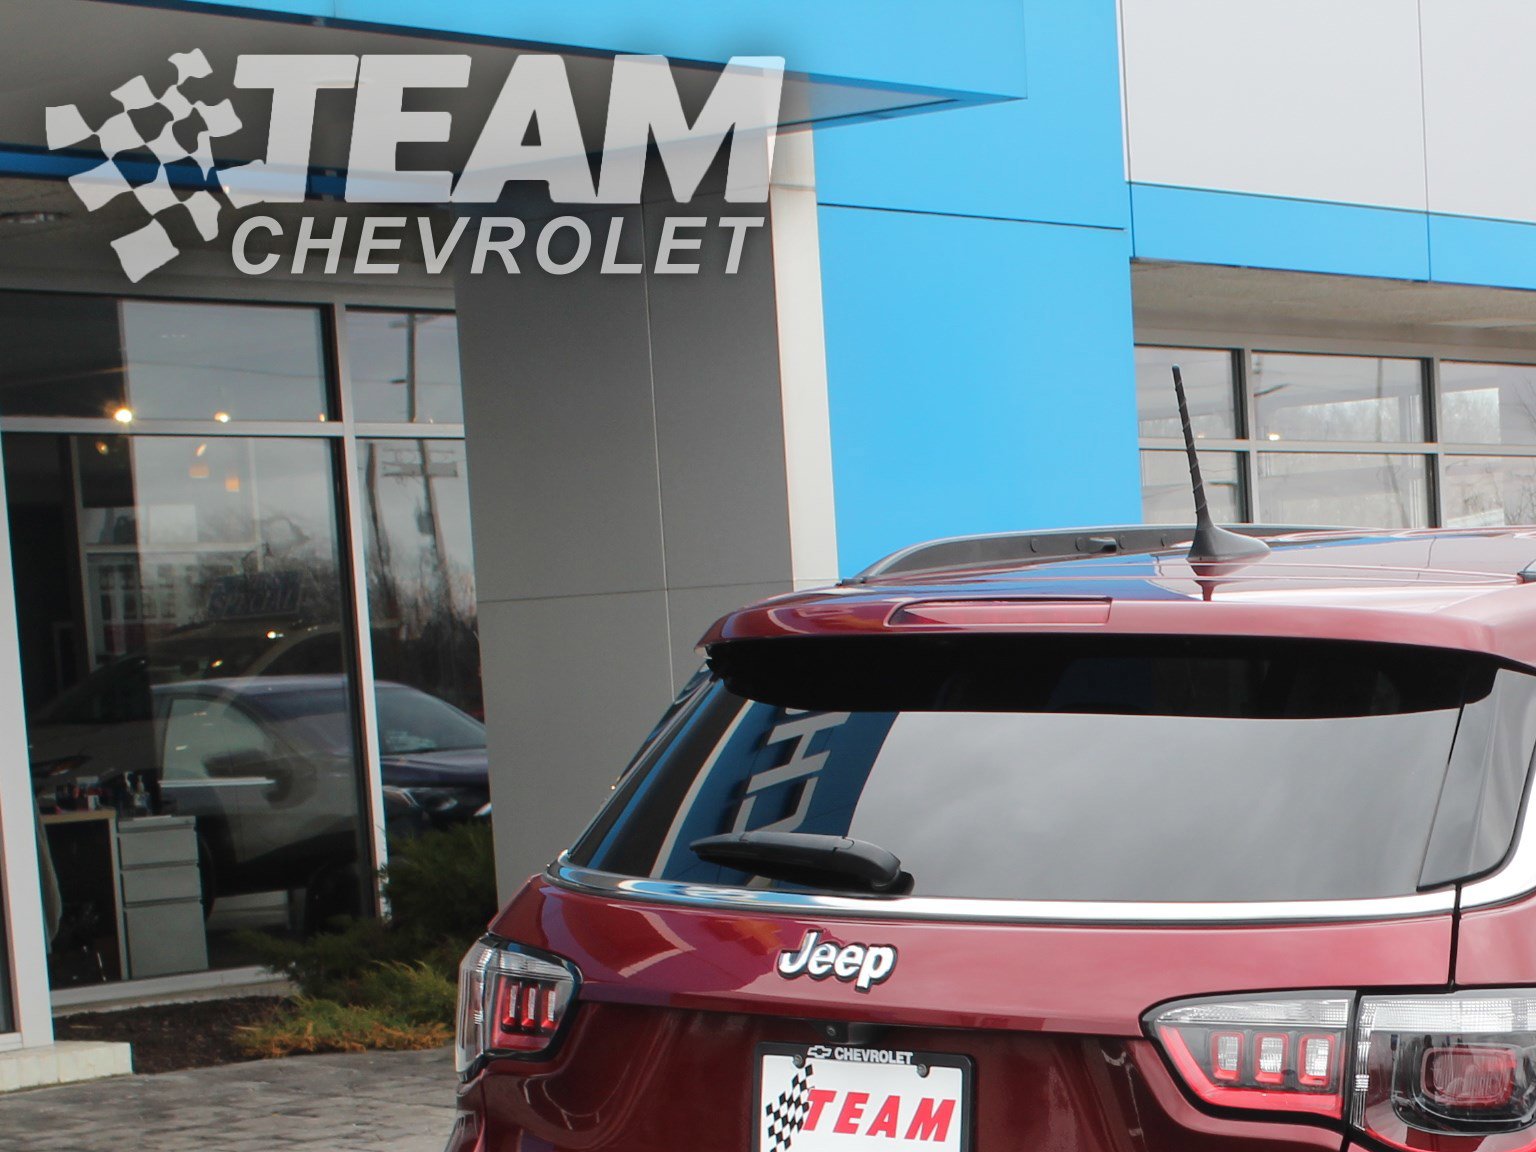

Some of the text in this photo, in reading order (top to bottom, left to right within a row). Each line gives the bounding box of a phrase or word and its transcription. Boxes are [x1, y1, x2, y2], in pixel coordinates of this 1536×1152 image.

[777, 929, 897, 993] Jeep
[834, 1046, 914, 1065] CHEVROLET
[802, 1088, 956, 1143] TEAM
